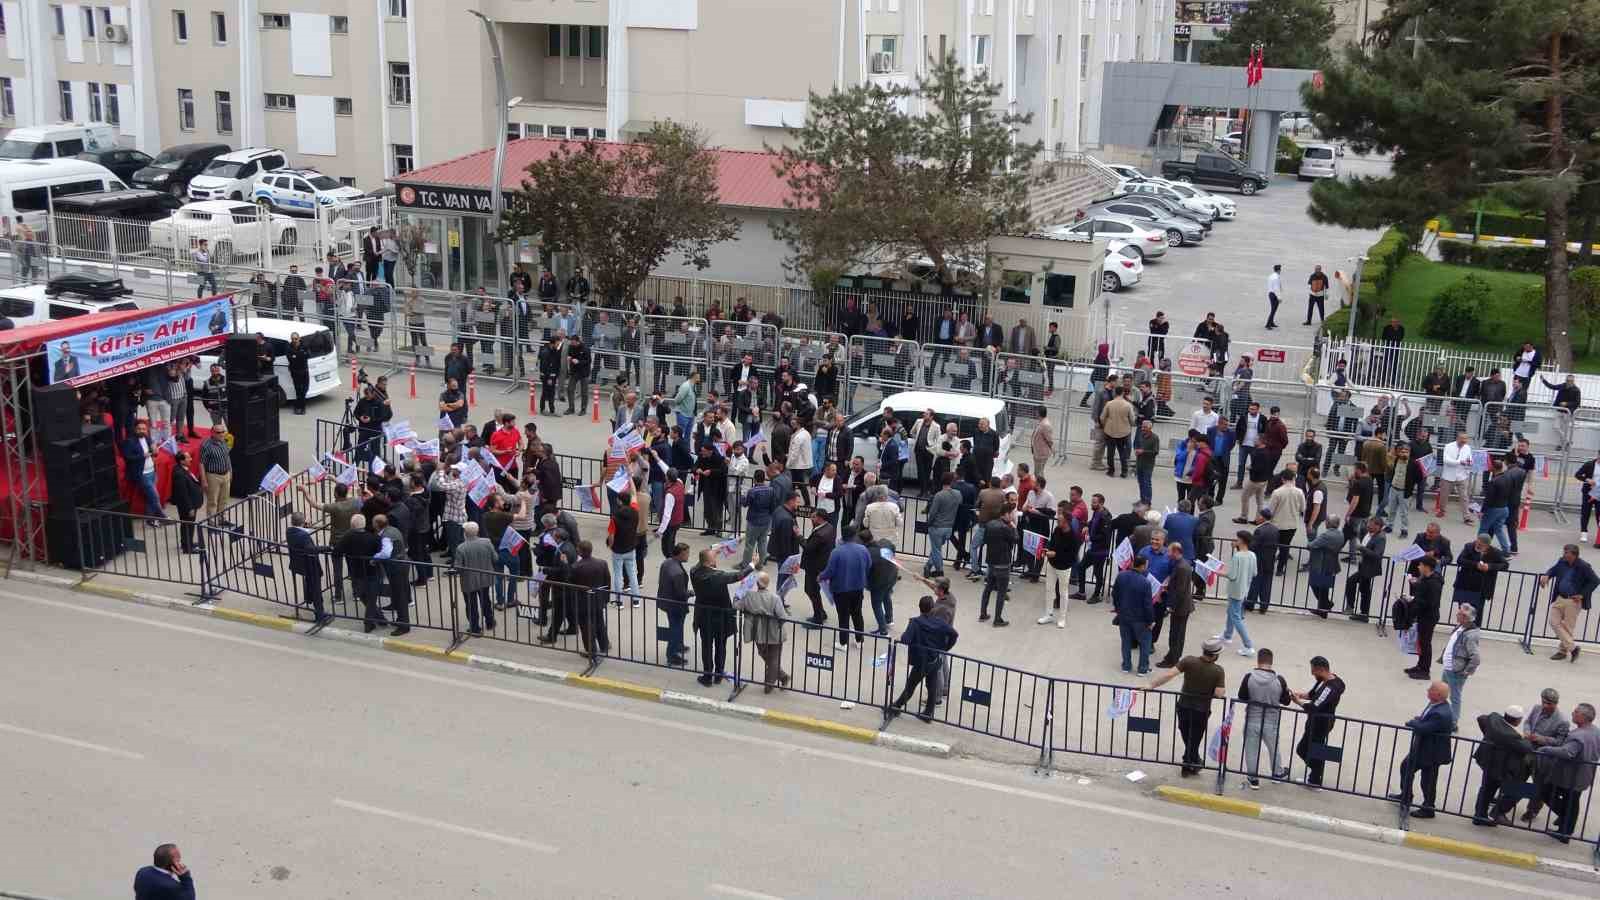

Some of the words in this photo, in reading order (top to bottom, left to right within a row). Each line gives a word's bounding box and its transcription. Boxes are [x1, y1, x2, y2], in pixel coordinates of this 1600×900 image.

[418, 191, 441, 207] T.C.
[442, 193, 470, 209] VAN
[153, 312, 198, 339] AHİ
[518, 606, 540, 619] VAN
[807, 656, 832, 669] POLİS
